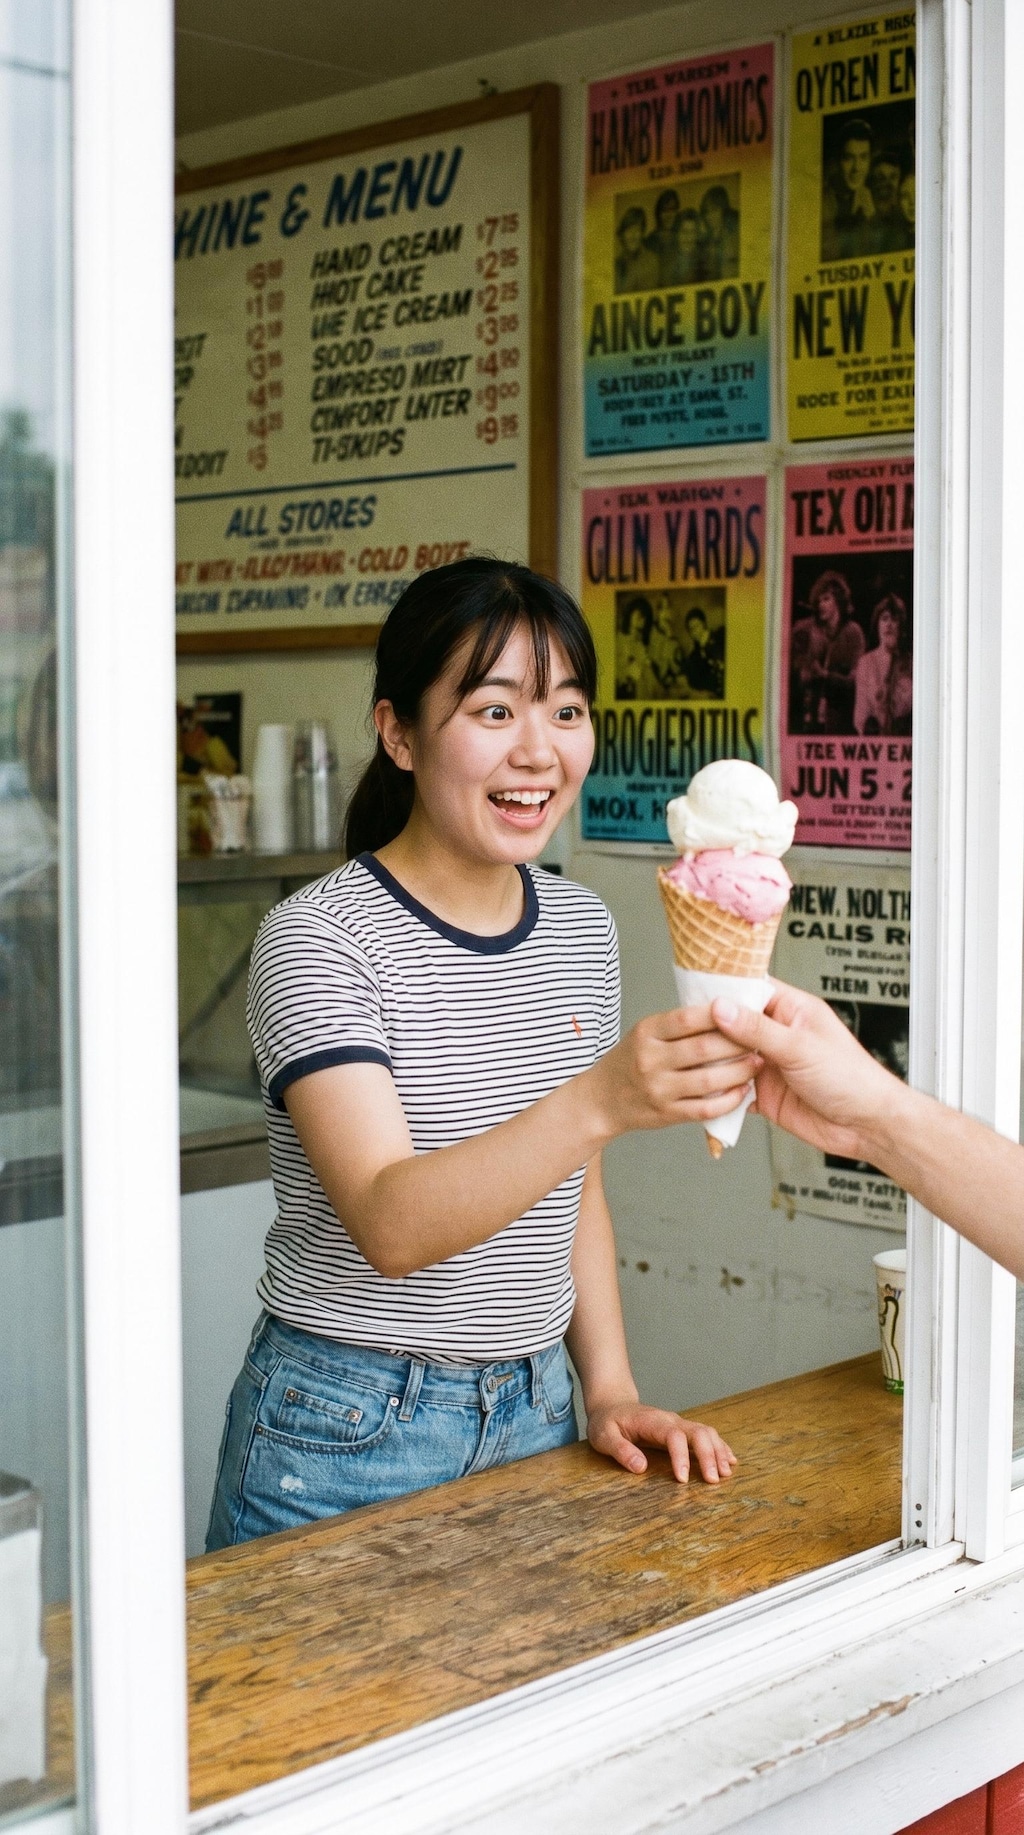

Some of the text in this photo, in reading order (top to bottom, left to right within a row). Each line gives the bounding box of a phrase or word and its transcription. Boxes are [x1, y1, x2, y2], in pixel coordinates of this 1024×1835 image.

[796, 53, 879, 113] QYREN
[674, 73, 770, 159] MOMICS
[280, 184, 311, 239] &
[322, 146, 464, 228] MENU
[310, 243, 372, 278] HAND
[378, 225, 464, 263] CREAM
[818, 260, 884, 285] TUSDAY
[366, 264, 427, 299] CAKE
[353, 302, 392, 334] ICE
[393, 288, 473, 327] CREAM
[588, 281, 766, 357] AINCE BOY
[793, 284, 870, 360] NEW
[311, 338, 374, 372] SOOD
[598, 368, 693, 397] SATURDAY
[225, 495, 378, 539] ALL STORES
[791, 487, 846, 537] TEX
[356, 545, 410, 575] COLD
[665, 504, 761, 581] YARDS
[842, 743, 882, 761] WAY
[790, 766, 849, 799] JUN
[860, 768, 878, 800] 5
[788, 920, 874, 943] CALIS
[820, 975, 869, 994] TREM
